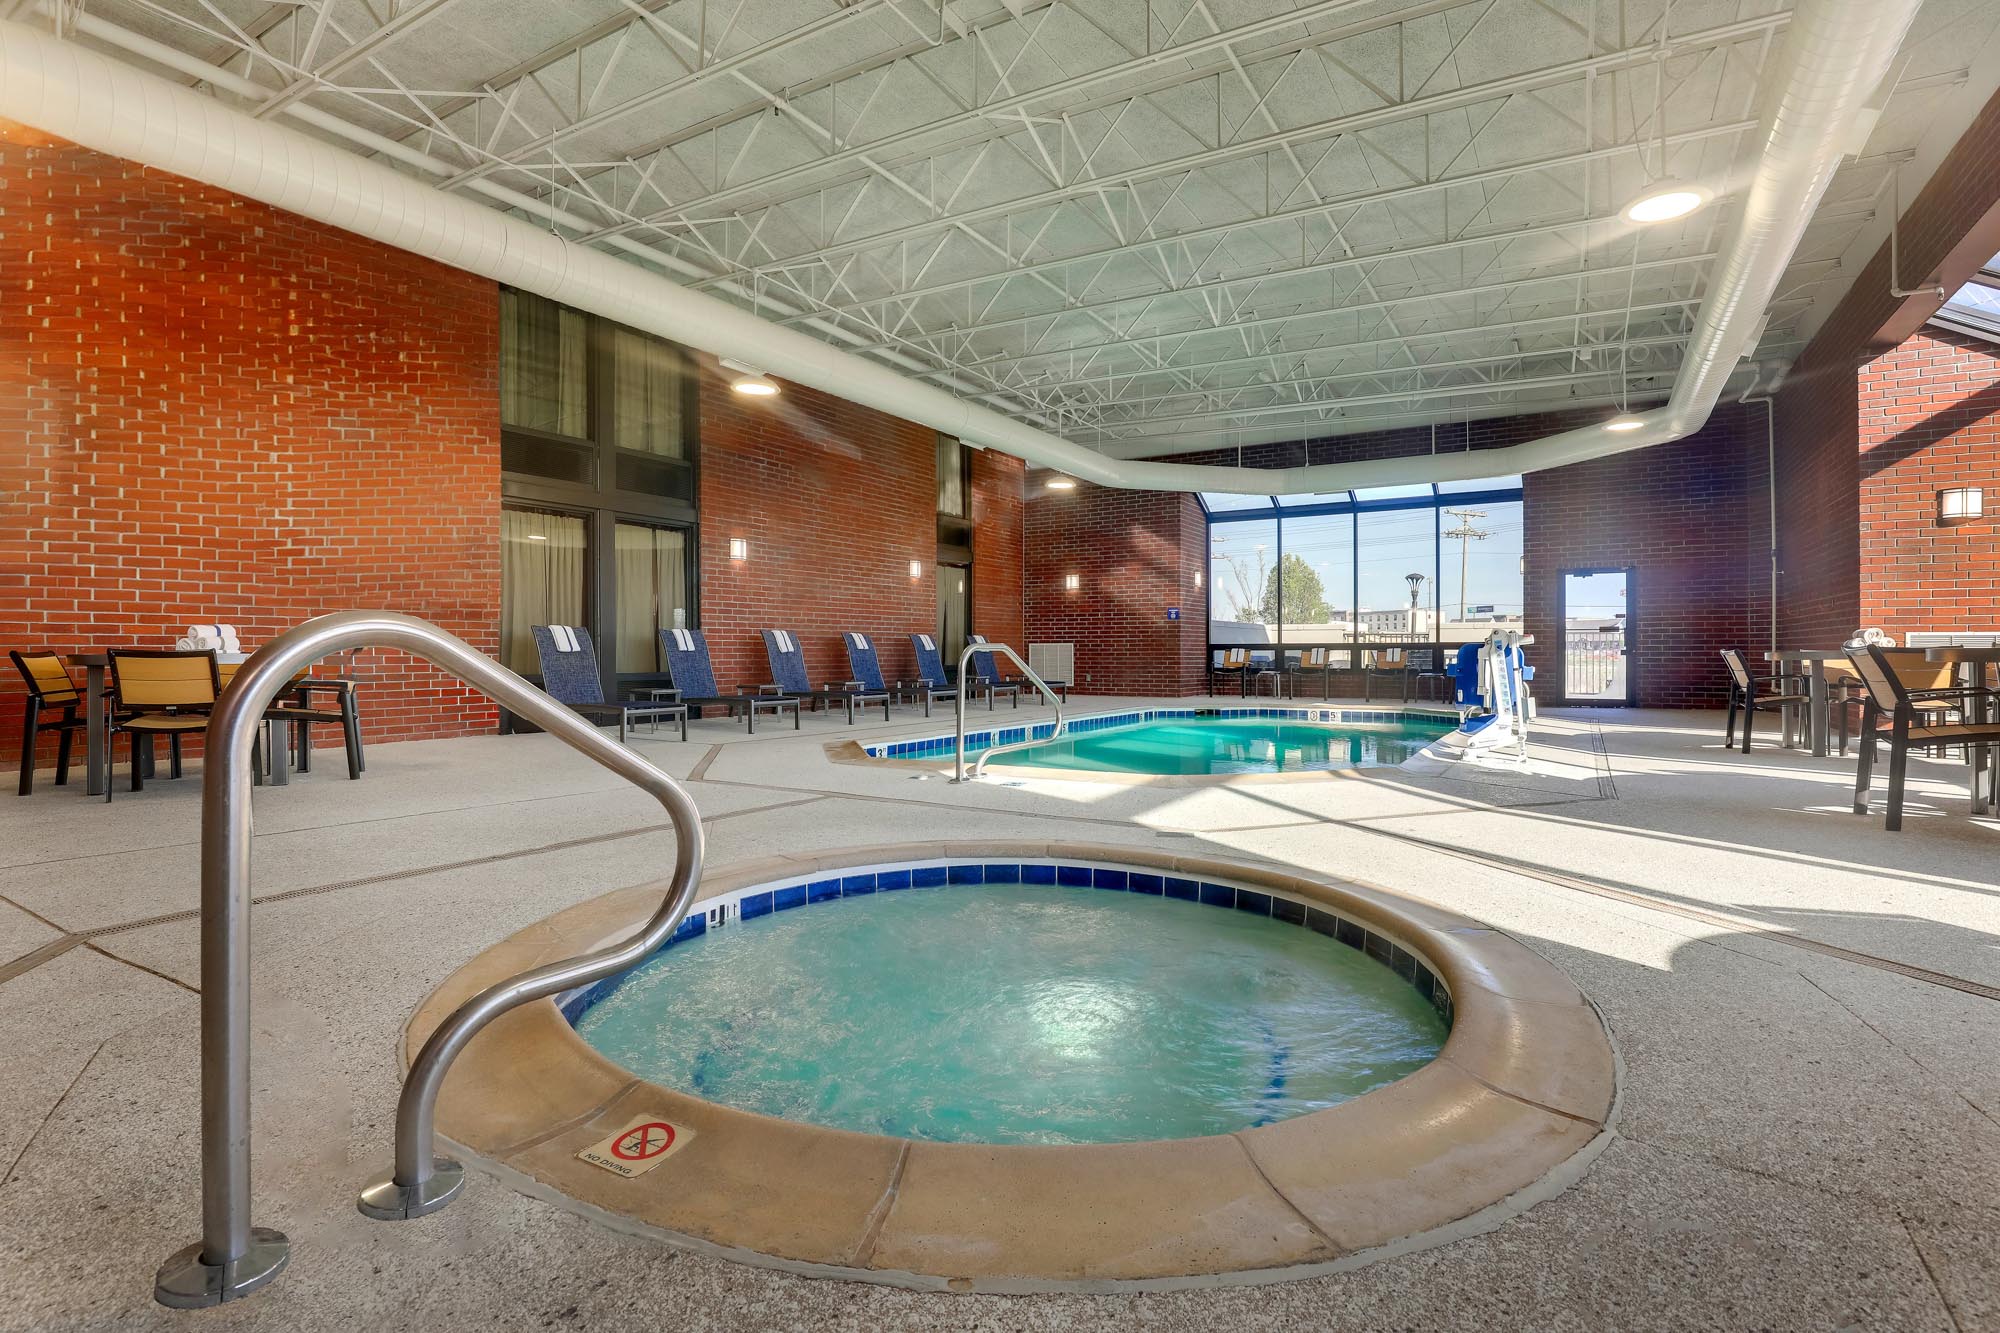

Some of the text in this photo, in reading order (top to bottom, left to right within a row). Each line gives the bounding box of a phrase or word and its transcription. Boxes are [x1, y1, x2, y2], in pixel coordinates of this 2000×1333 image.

[1330, 711, 1336, 719] 5
[584, 1153, 632, 1174] NO DIVING
